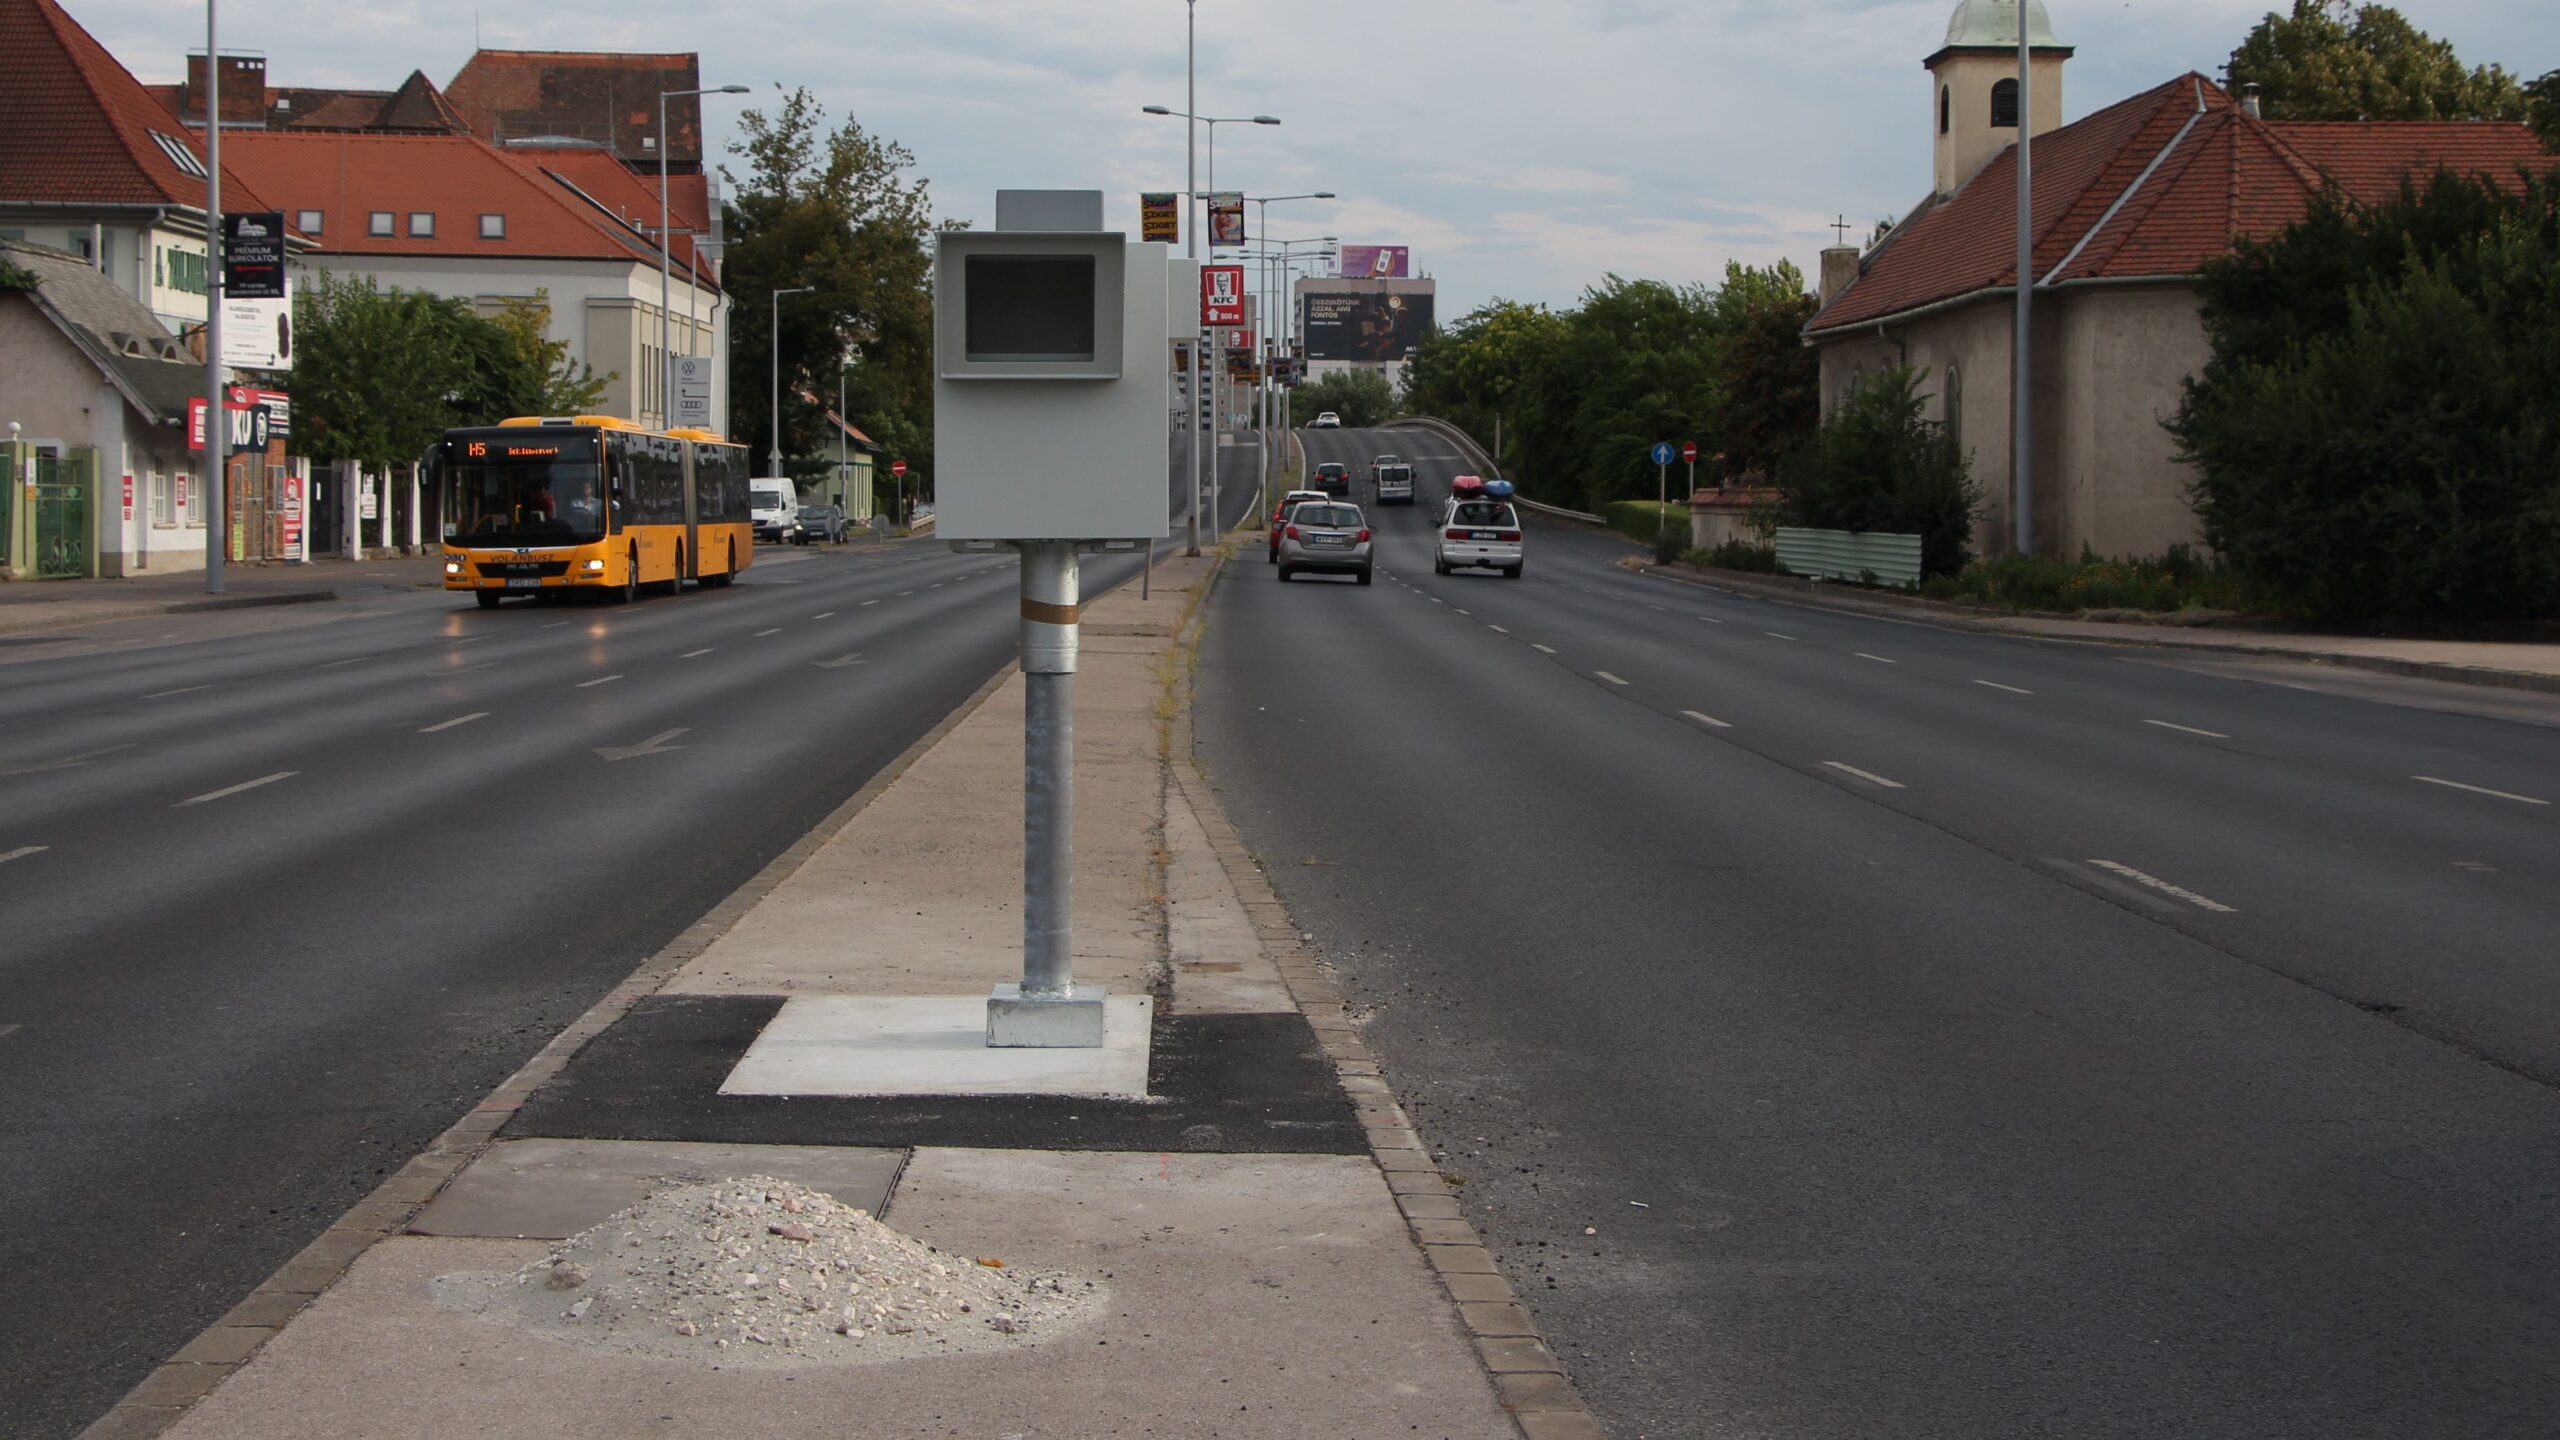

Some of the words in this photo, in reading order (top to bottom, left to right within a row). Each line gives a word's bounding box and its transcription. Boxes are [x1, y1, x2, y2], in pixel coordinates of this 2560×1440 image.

[1209, 200, 1242, 209] SZIGET
[1143, 211, 1176, 220] SZIGET
[1143, 222, 1176, 231] SZIGET
[234, 245, 271, 254] PRÉMIUM
[228, 254, 279, 263] BURKOLATOK
[1213, 296, 1234, 304] KFC
[469, 443, 486, 456] H5
